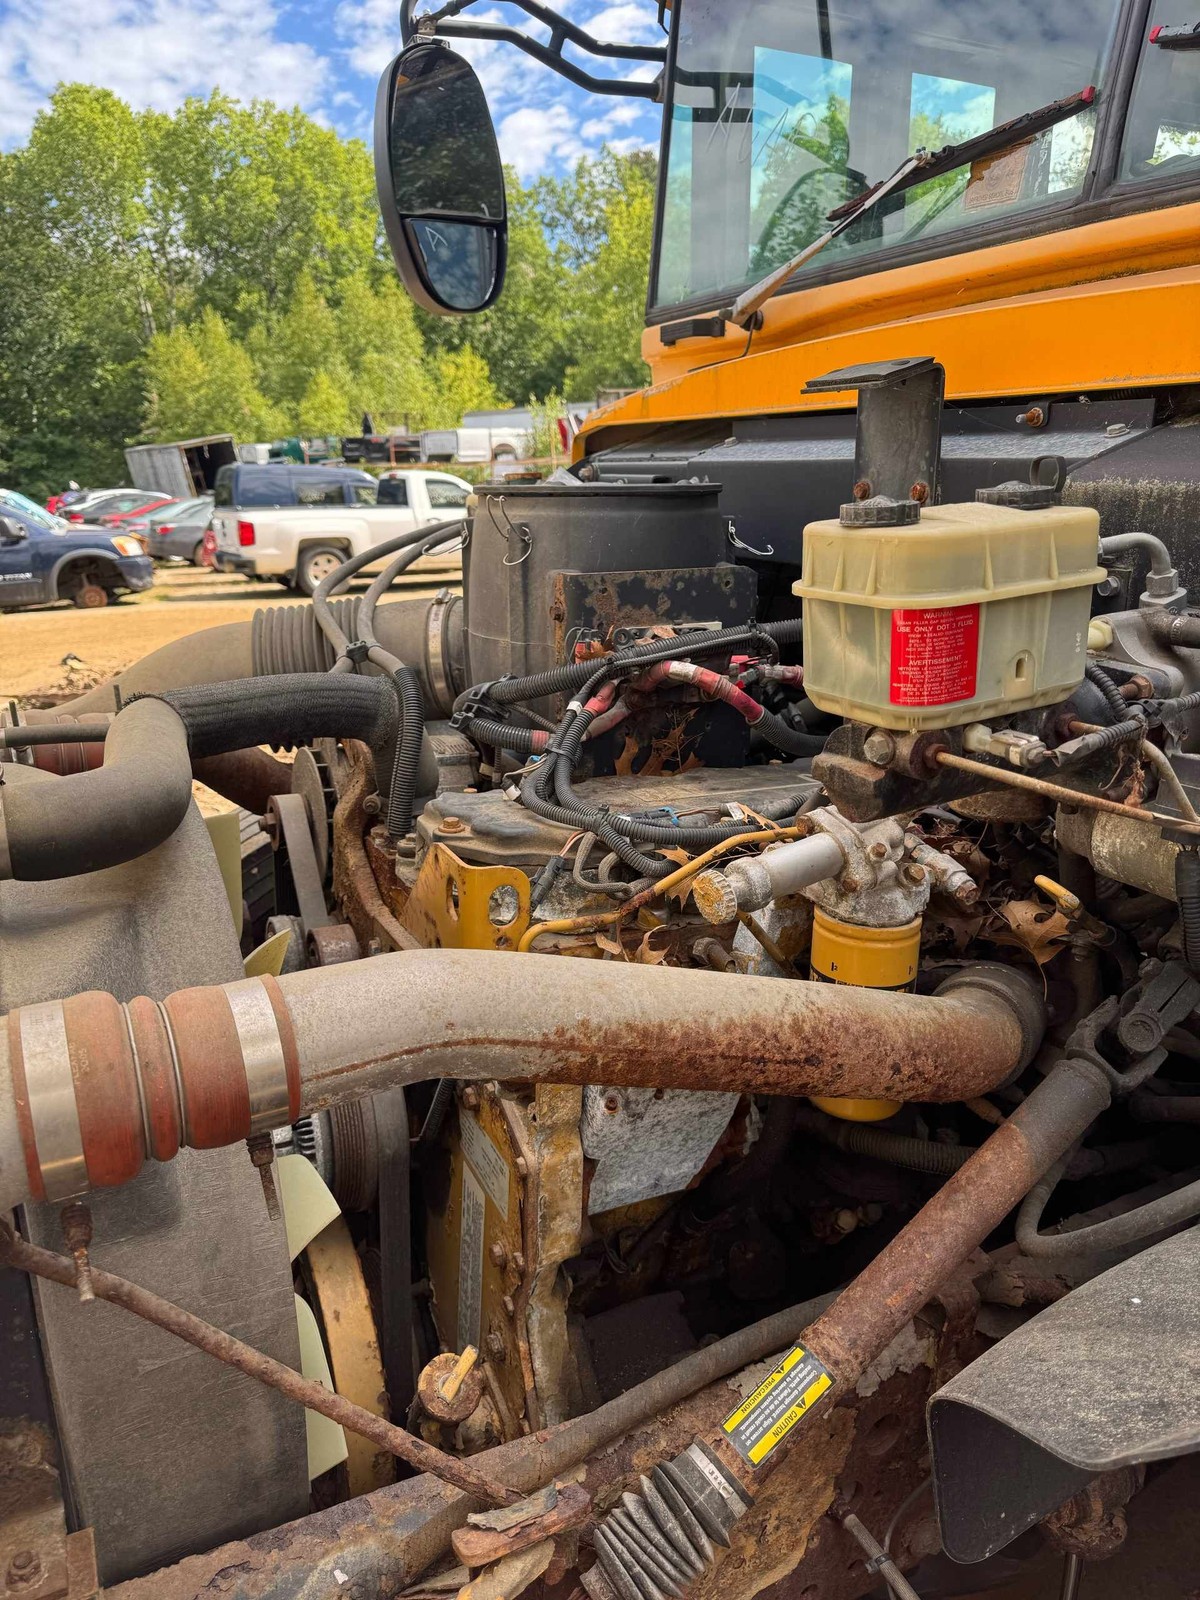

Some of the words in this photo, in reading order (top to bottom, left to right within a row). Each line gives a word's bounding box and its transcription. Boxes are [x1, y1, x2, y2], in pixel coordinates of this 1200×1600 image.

[958, 619, 973, 627] FLUID
[909, 655, 962, 665] AVERTISSEMENT
[797, 1370, 818, 1392] Component
[741, 1377, 775, 1413] PRECAUCION
[784, 1389, 799, 1405] damage
[762, 1417, 773, 1428] Align
[772, 1410, 798, 1437] CAUTION
[750, 1427, 764, 1441] arrows
